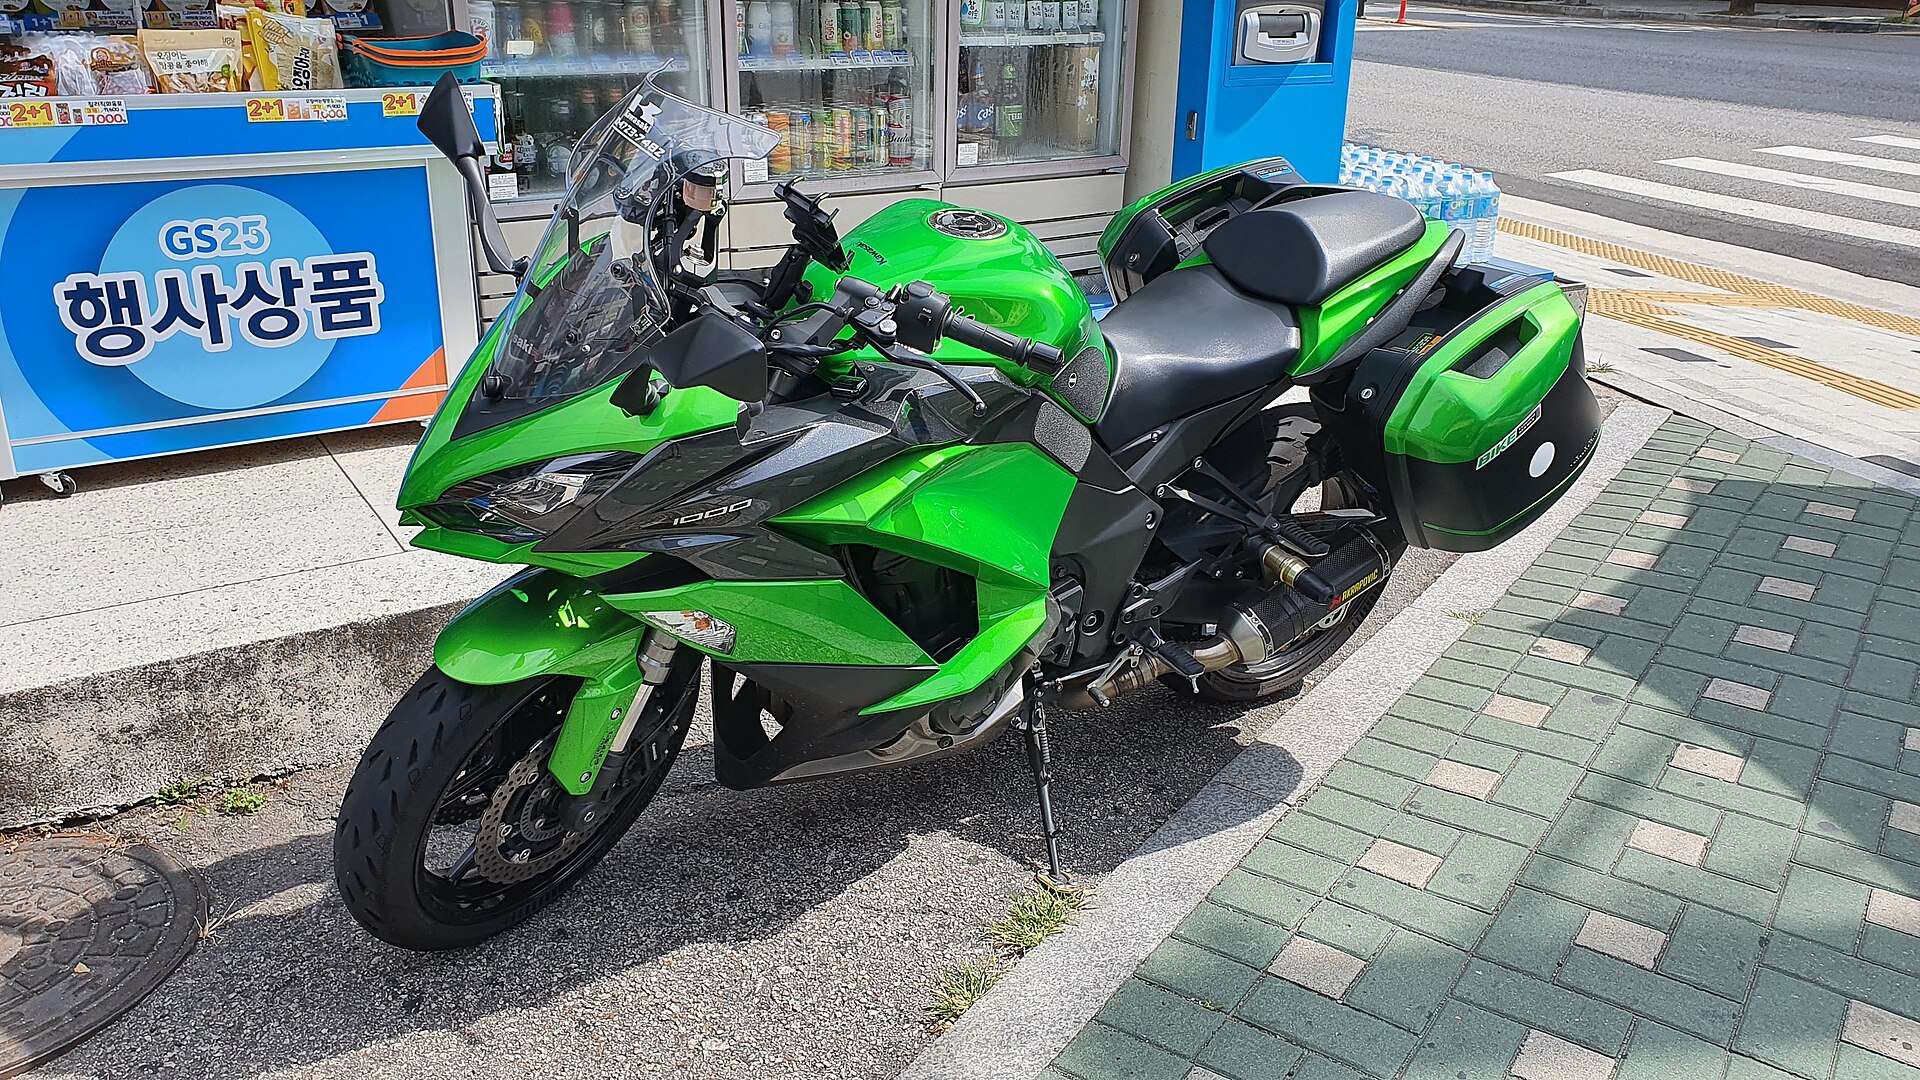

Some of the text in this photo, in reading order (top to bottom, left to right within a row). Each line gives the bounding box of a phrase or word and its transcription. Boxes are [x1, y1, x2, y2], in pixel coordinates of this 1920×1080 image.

[10, 102, 53, 122] 2+1
[247, 99, 285, 117] 2+1
[382, 93, 417, 111] 2+1
[165, 220, 264, 256] GS25
[63, 259, 378, 358] 행사상품
[672, 498, 753, 526] 1000
